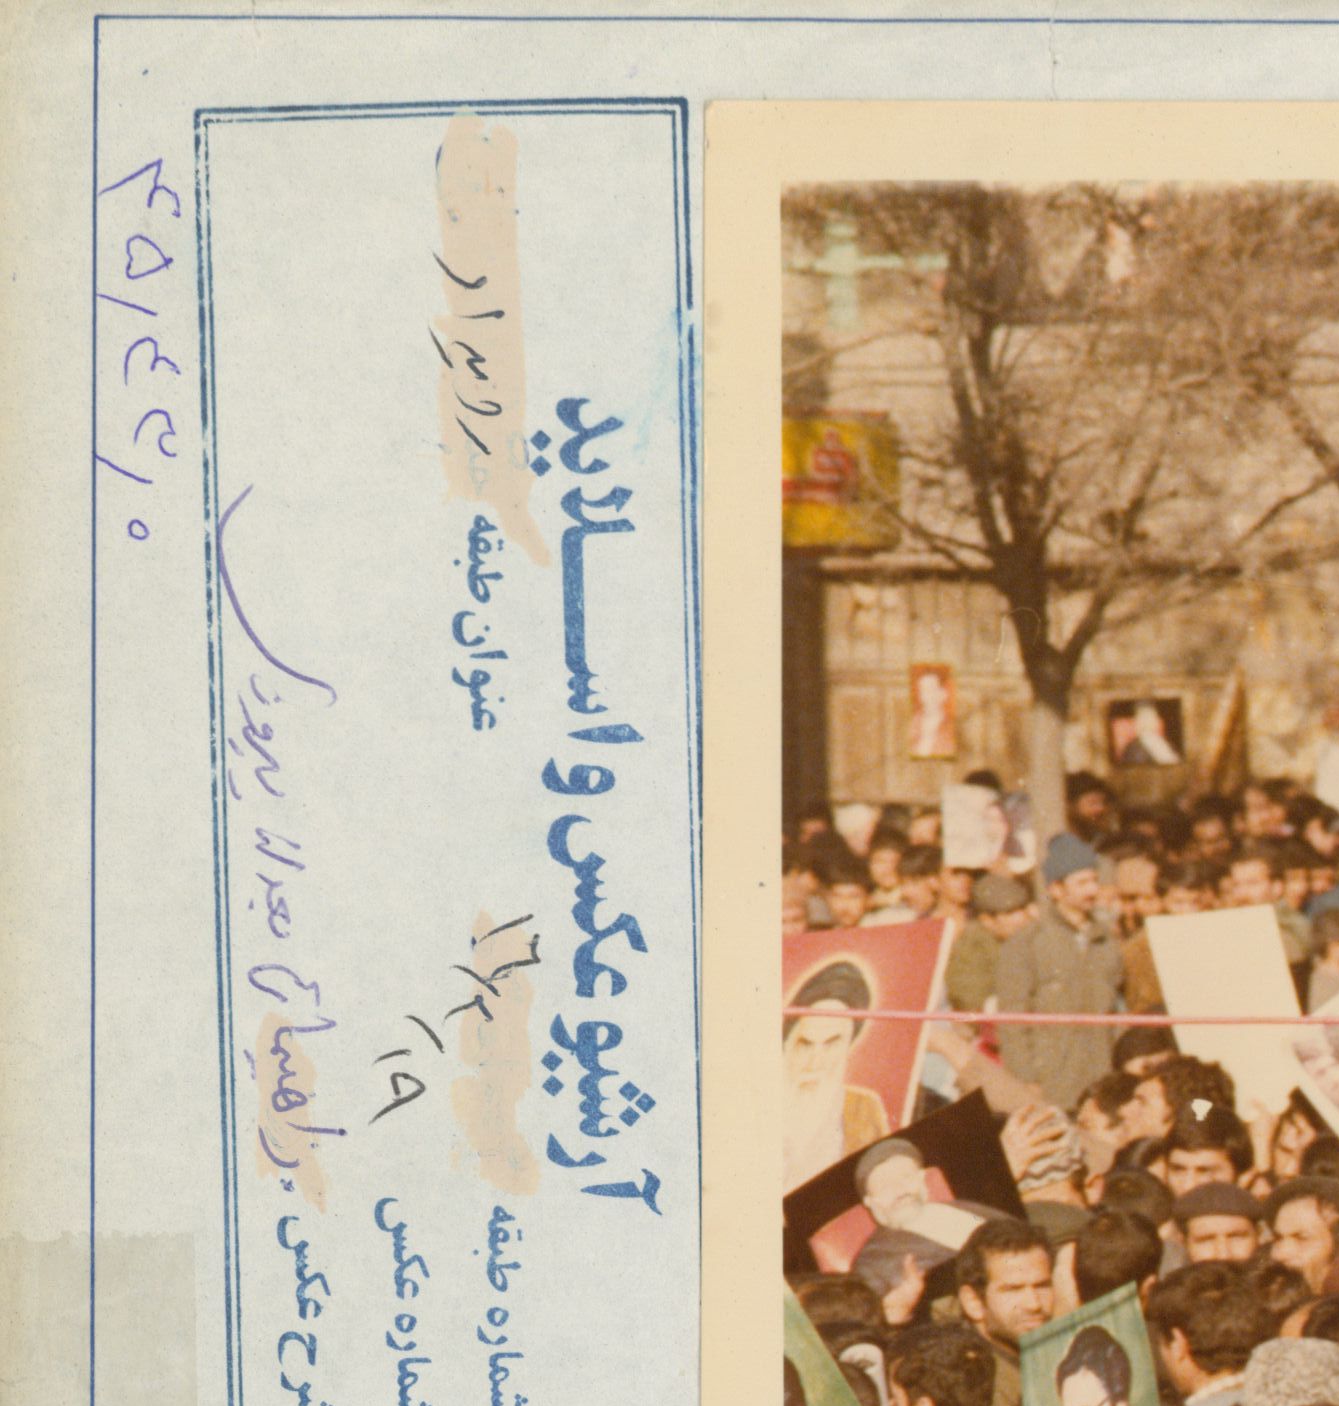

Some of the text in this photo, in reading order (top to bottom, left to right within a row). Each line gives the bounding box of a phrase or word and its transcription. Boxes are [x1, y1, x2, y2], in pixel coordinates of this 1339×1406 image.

[451, 514, 509, 733] عنوان طبقه
[528, 397, 662, 1216] آرشیو عکس و اسلاید
[277, 1216, 330, 1320] عکس
[374, 1198, 430, 1299] عکس
[473, 1205, 522, 1292] طبقه
